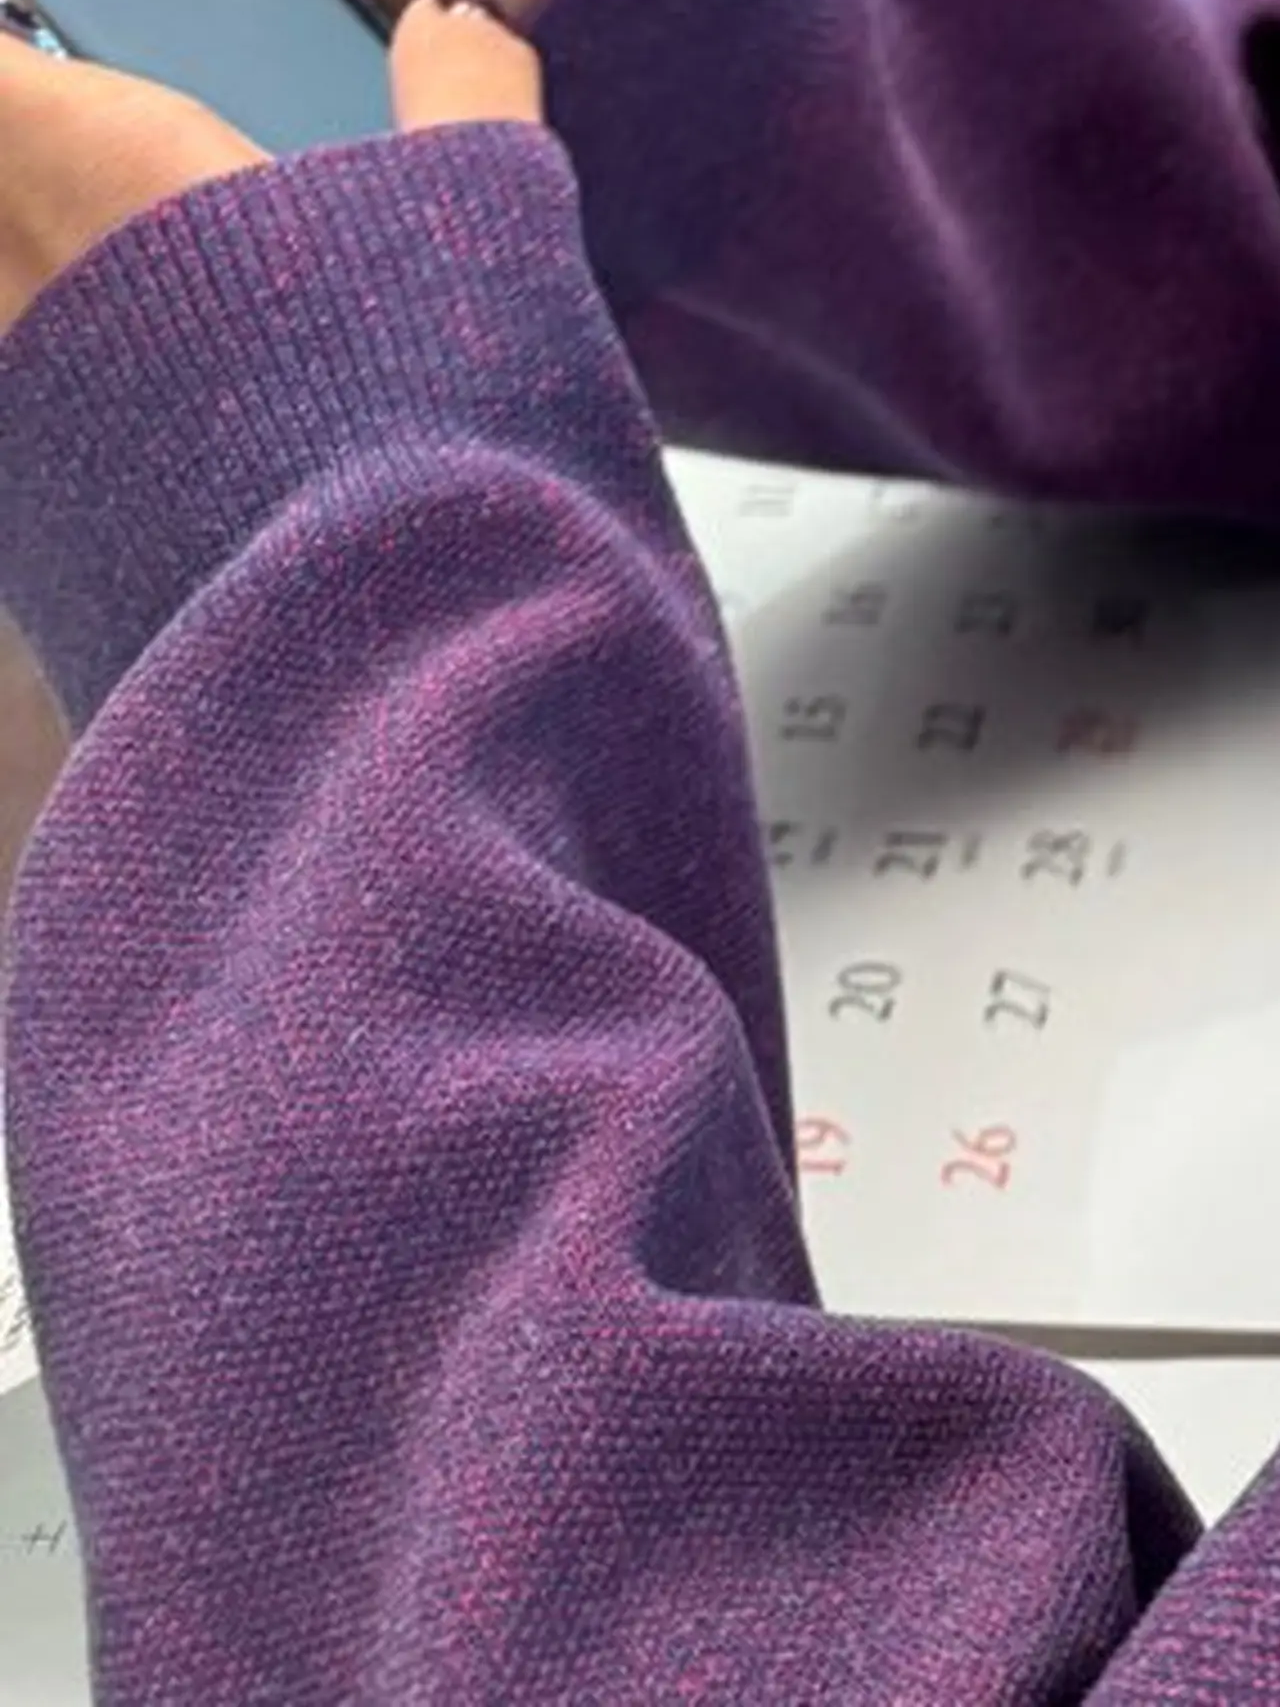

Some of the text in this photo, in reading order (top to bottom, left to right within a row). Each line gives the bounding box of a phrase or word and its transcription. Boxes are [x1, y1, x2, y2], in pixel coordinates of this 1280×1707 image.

[873, 831, 949, 882] 21
[1020, 828, 1092, 888] 28
[827, 961, 903, 1023] 20
[983, 967, 1053, 1030] 27
[795, 1116, 853, 1178] 19
[940, 1122, 1018, 1191] 26
